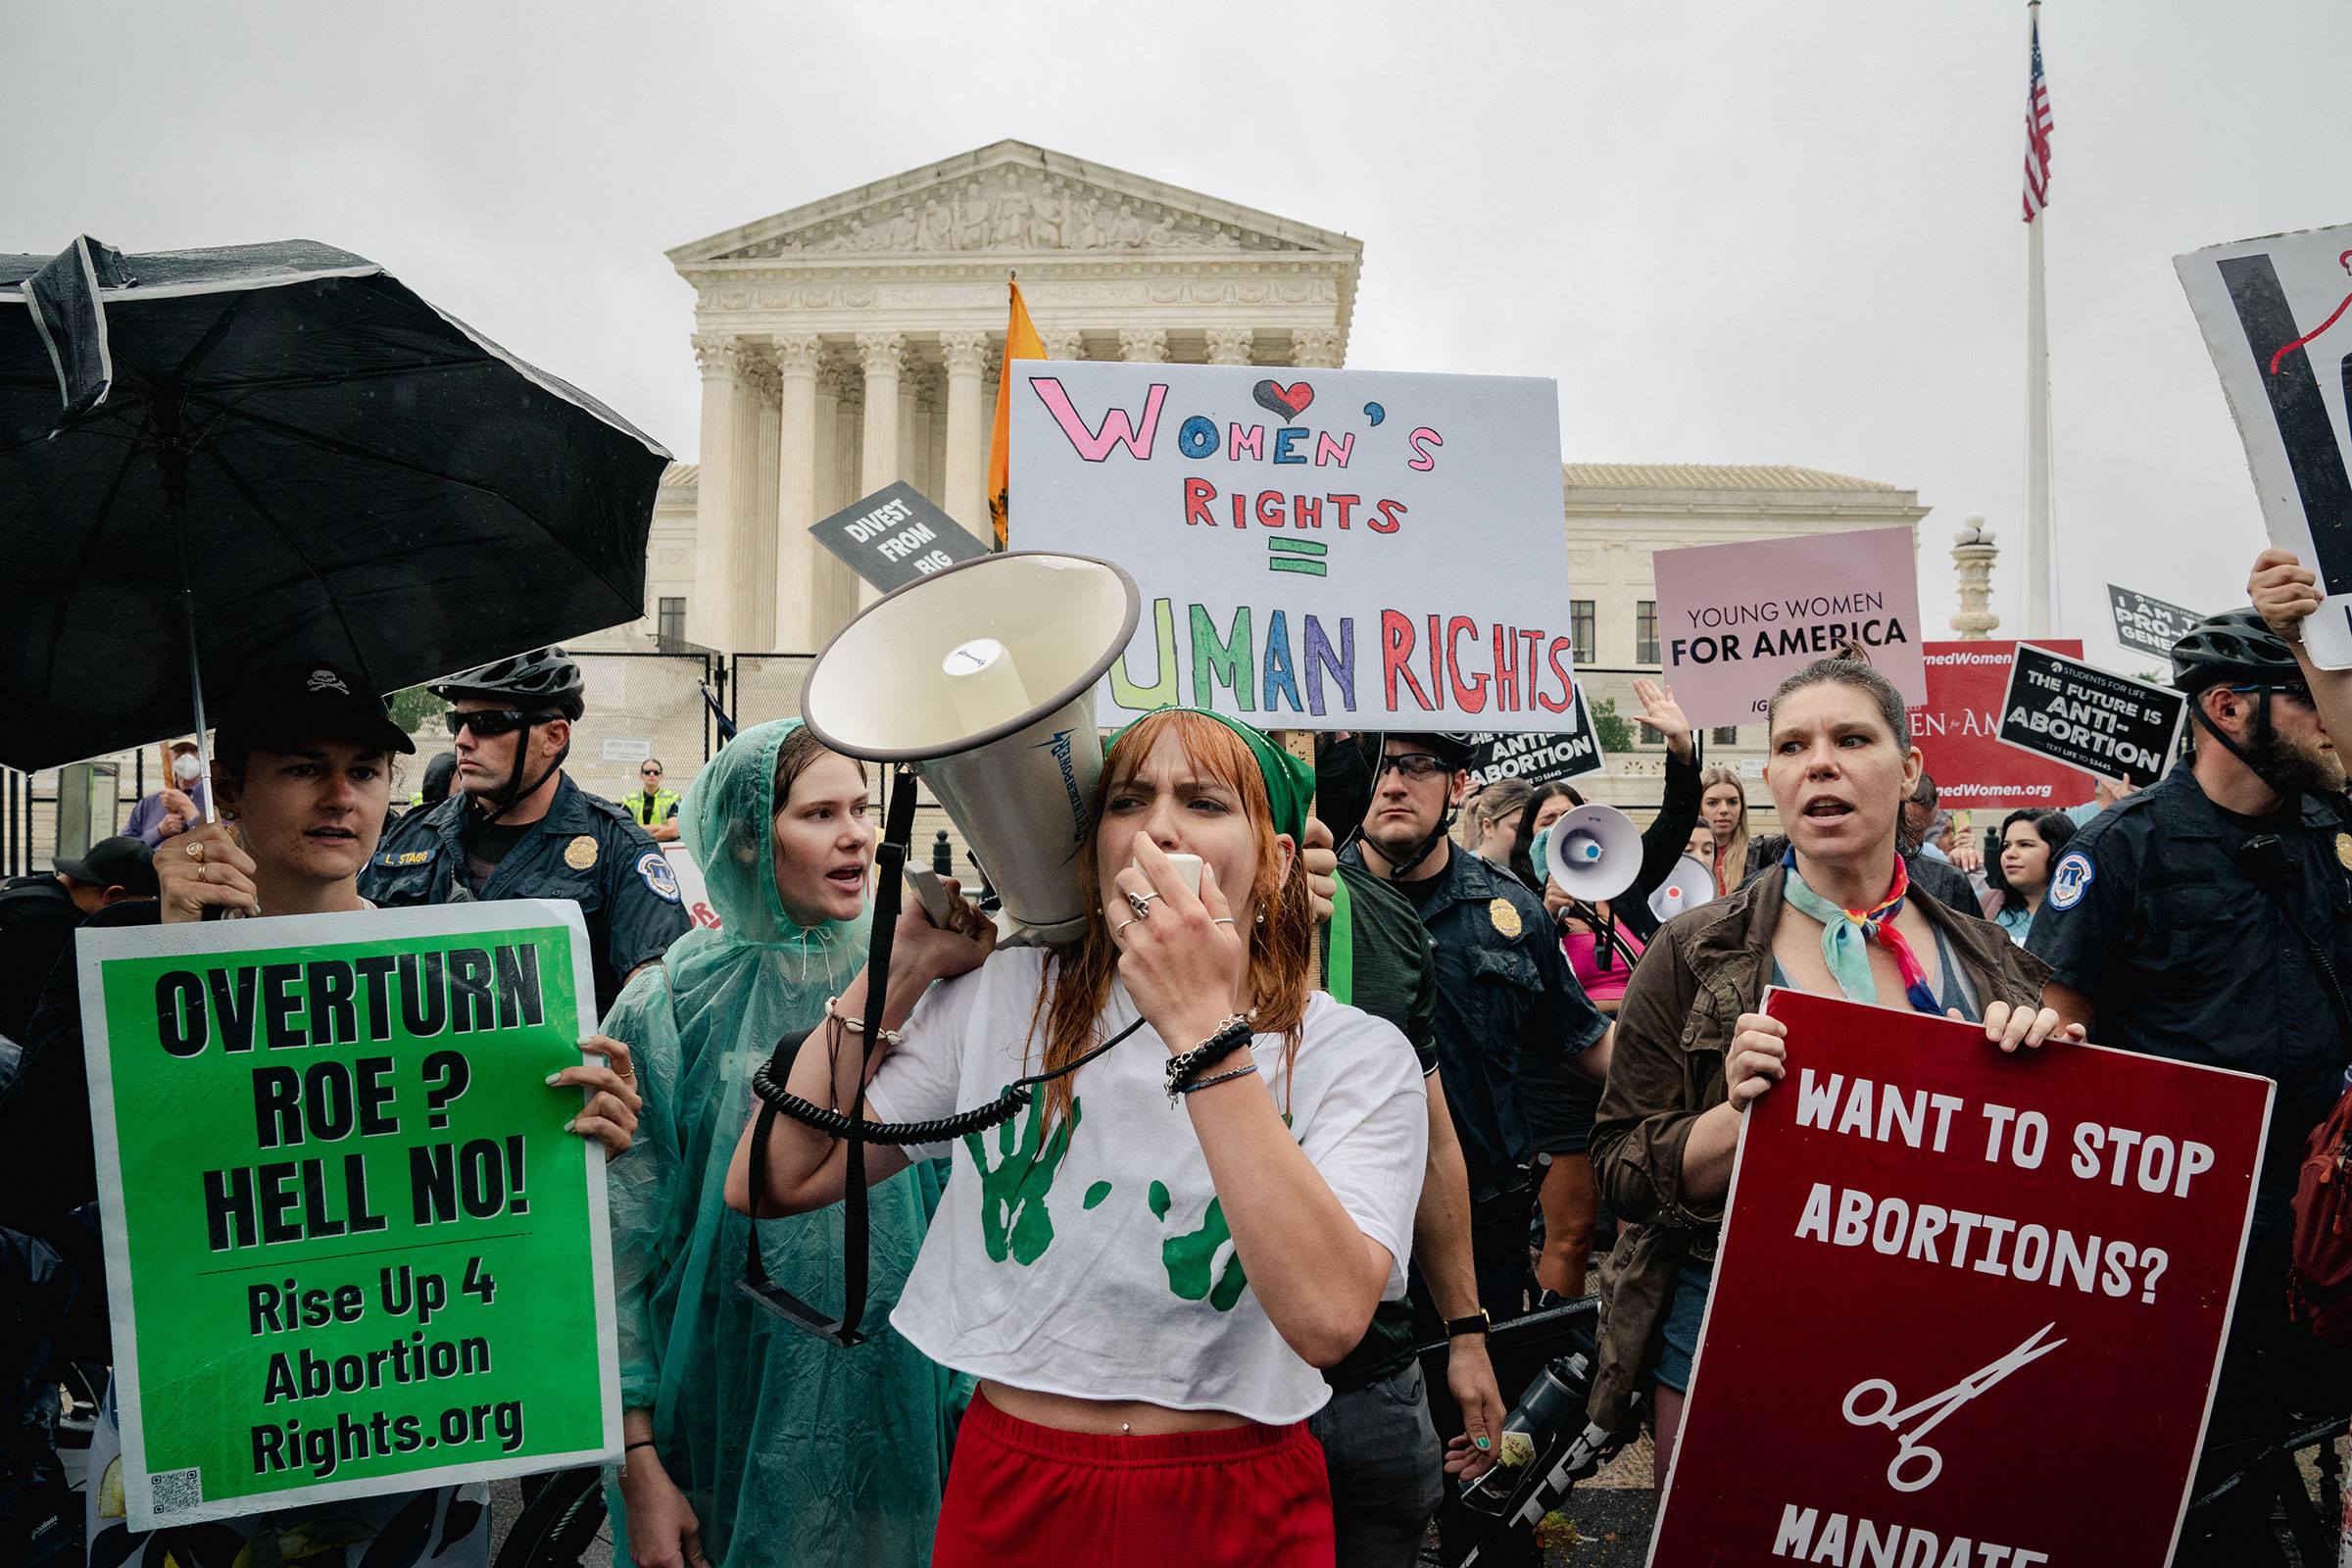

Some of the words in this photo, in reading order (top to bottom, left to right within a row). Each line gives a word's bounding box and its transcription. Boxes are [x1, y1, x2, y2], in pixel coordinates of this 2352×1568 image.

[843, 498, 913, 544] DIVEST
[1183, 477, 1408, 534] RIGHTS
[876, 521, 938, 564] FROM
[1687, 602, 1780, 629] YOUNG
[1785, 591, 1883, 619] WOMEN
[2136, 603, 2173, 623] AM
[1108, 598, 1357, 717] UMAN
[1380, 609, 1576, 714] RIGHTS
[1671, 634, 1742, 666] FOR
[1752, 618, 1908, 659] AMERICA
[2121, 625, 2176, 652] GENE
[2028, 669, 2062, 692] THE
[2066, 683, 2139, 717] FUTURE
[2143, 709, 2163, 725] IS
[2063, 666, 2106, 687] STUDENTS
[2108, 680, 2127, 694] FOR
[2128, 687, 2146, 700] LIFE
[2007, 706, 2161, 773] ABORTION
[2046, 696, 2130, 734] ANTI-
[1471, 735, 1592, 786] ABORTION
[2045, 742, 2063, 753] TEXT
[2062, 748, 2078, 759] LIFE
[2079, 753, 2088, 763] TO
[1051, 734, 1092, 842] THUNDERPOWER
[1936, 784, 2052, 798] nedWomen.org
[384, 854, 395, 865] L.
[398, 851, 428, 864] STAGG
[155, 943, 545, 1058] OVERTURN
[252, 1055, 401, 1150] ROE
[421, 1050, 470, 1130] ?
[1795, 1068, 1964, 1153] WANT
[1982, 1102, 2049, 1170] TO
[2072, 1122, 2216, 1200] STOP
[203, 1153, 388, 1251] HELL
[410, 1135, 530, 1227] NO!
[1794, 1182, 2169, 1305] ABORTIONS?
[247, 1278, 365, 1336] Rise
[380, 1264, 447, 1324] Up
[462, 1256, 497, 1304] 4
[263, 1331, 492, 1405] Abortion
[251, 1397, 525, 1479] Rights.org
